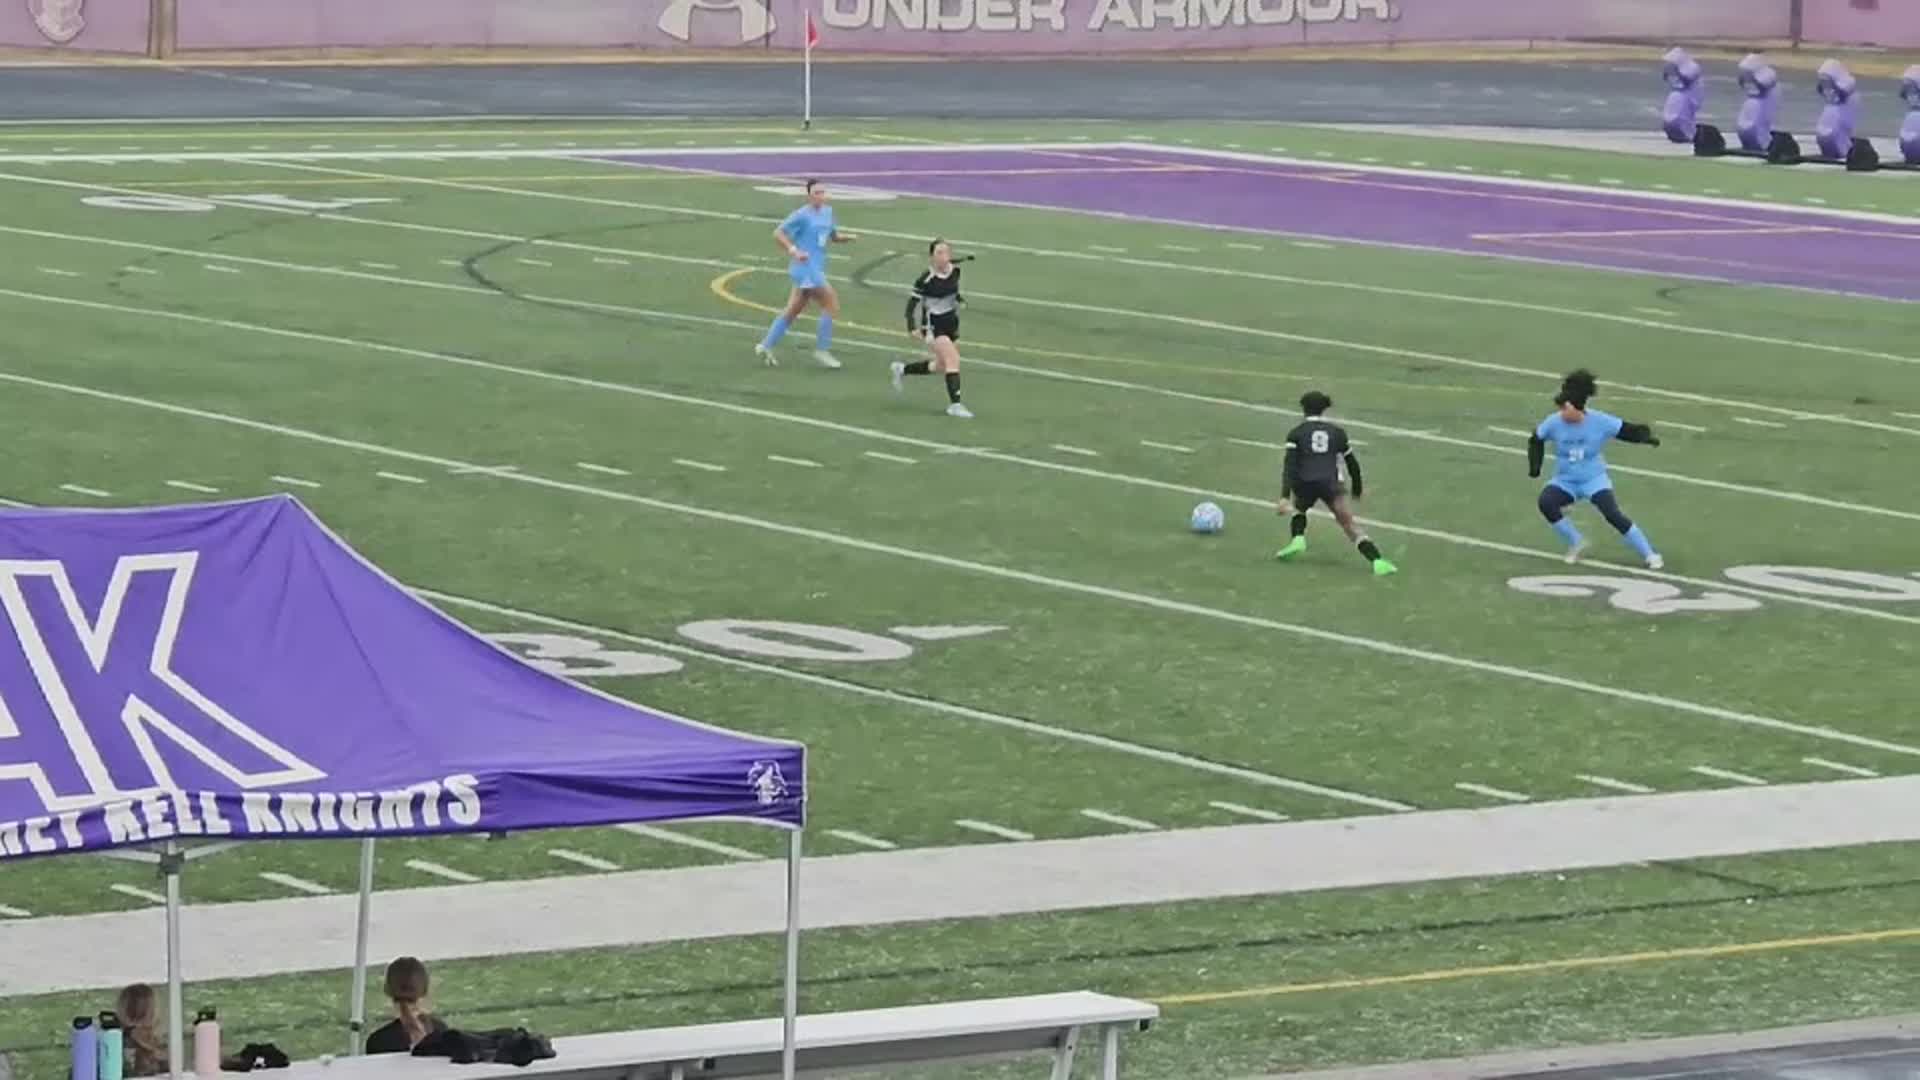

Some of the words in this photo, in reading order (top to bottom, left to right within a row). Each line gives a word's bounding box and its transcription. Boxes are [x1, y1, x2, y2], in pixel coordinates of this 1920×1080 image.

[823, 0, 1065, 32] UNDER
[1087, 0, 1393, 31] ARMOUR
[1507, 564, 1920, 614] 20
[104, 790, 231, 843] KELL
[242, 773, 481, 833] KNIGHTS
